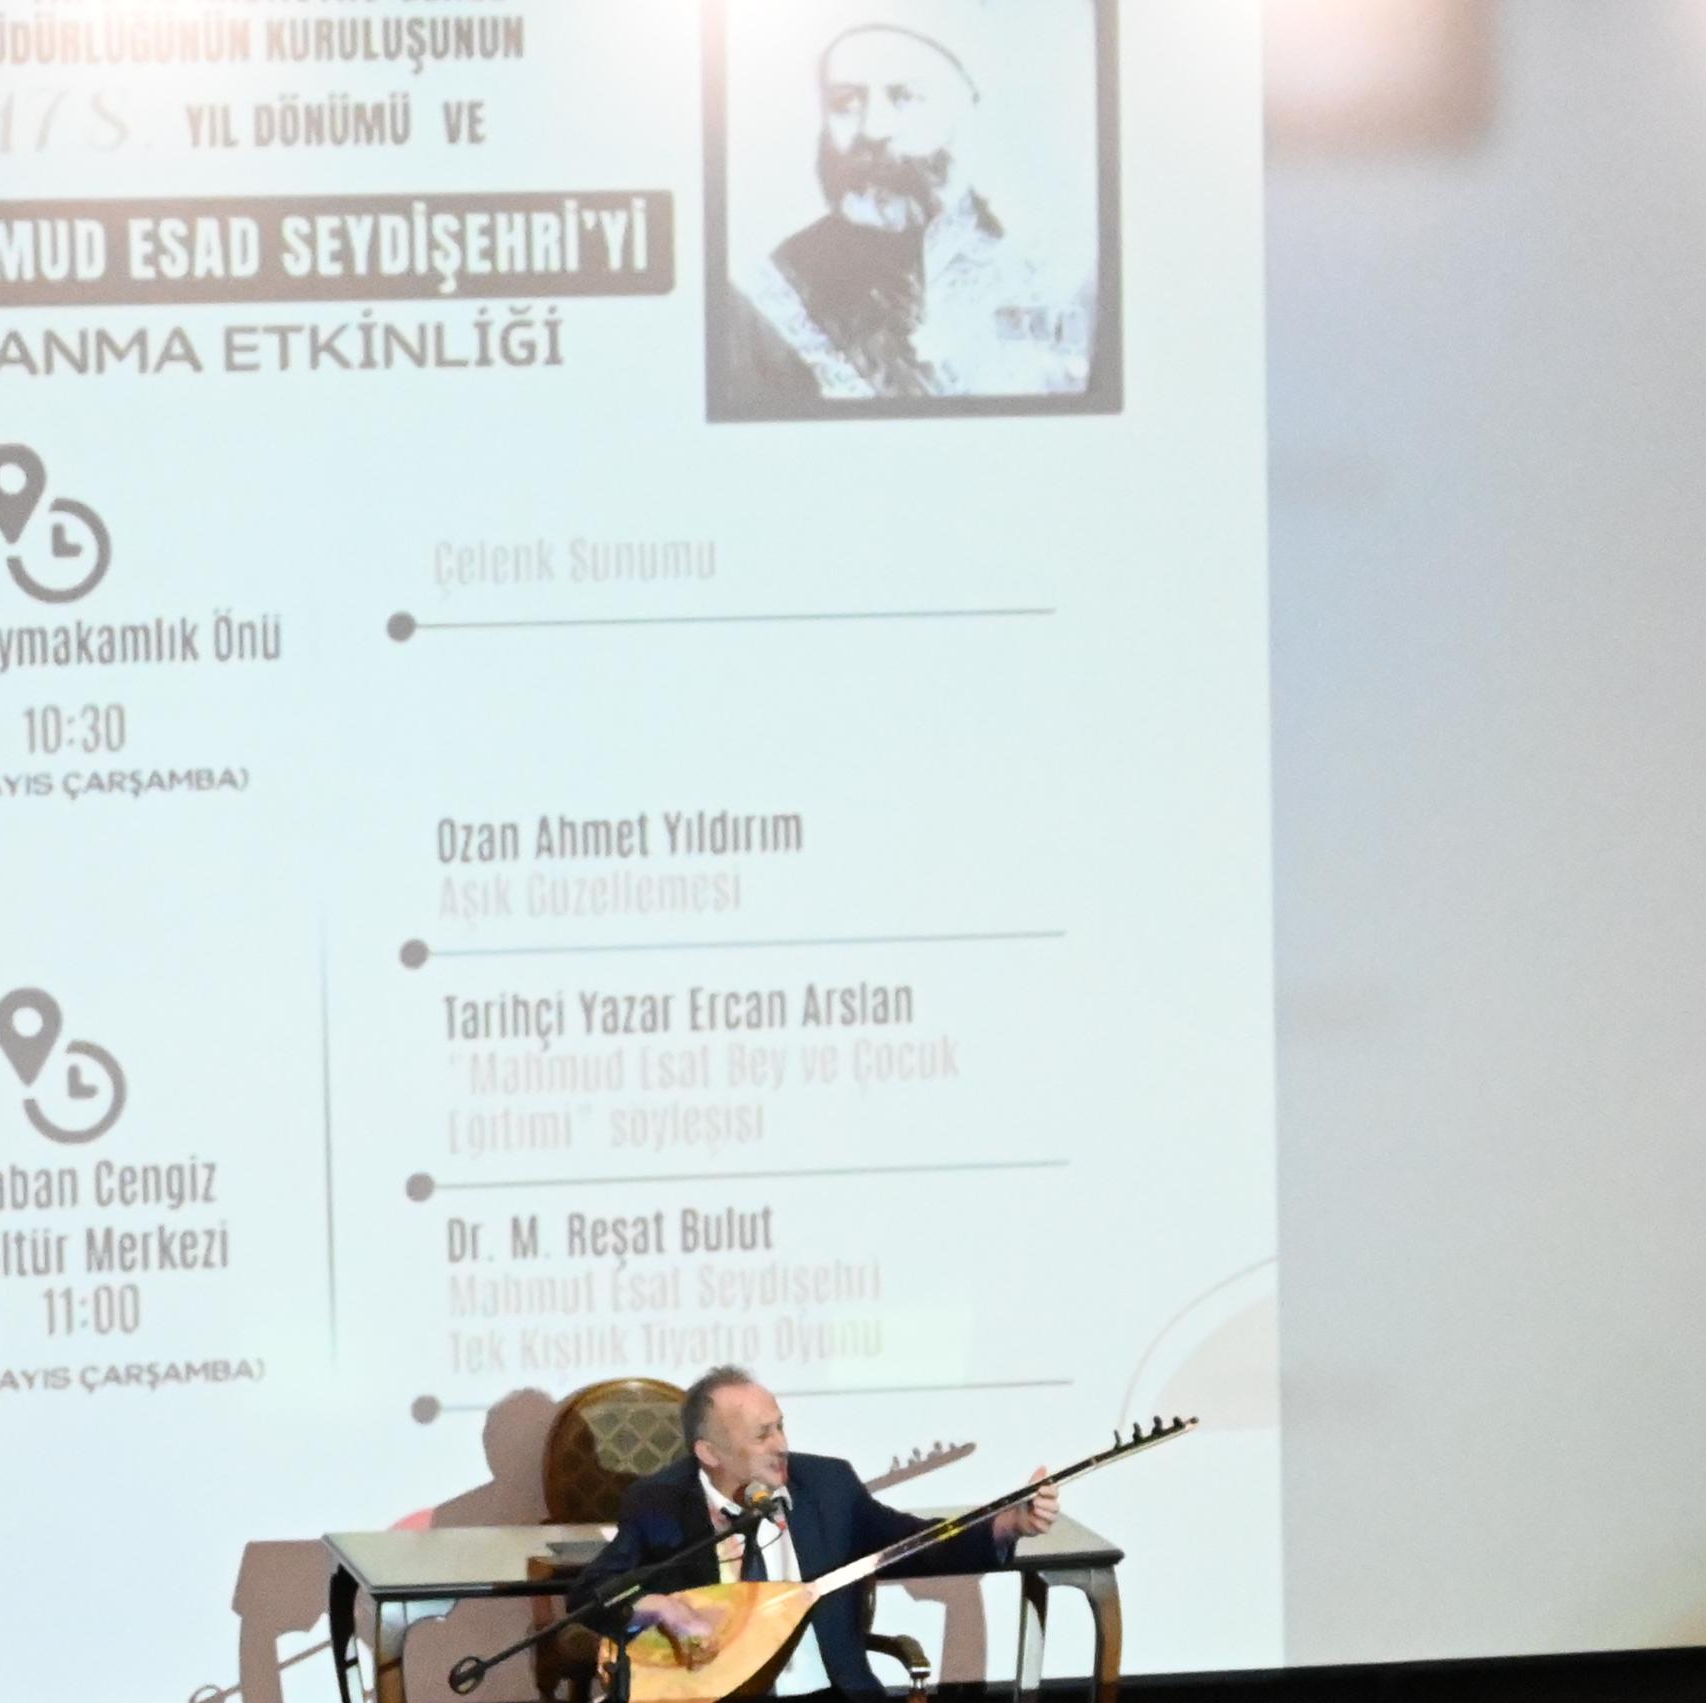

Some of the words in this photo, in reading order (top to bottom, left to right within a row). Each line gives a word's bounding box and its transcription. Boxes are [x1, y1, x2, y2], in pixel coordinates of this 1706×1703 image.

[266, 16, 525, 75] KURULUŞUNUN
[185, 103, 239, 148] YIL
[254, 93, 412, 148] DÖNÜMÜ
[442, 99, 487, 145] VE
[130, 214, 260, 281] ESAD
[281, 198, 650, 295] SEYDİŞEHRİ'Yİ
[223, 304, 564, 372] ETKİNLİĞİ
[433, 539, 556, 597] Çelenk
[568, 535, 717, 584] Sunumu
[213, 607, 282, 663] Önü
[24, 703, 127, 755] 10:30
[63, 766, 250, 801] ÇARŞAMBA)
[436, 817, 519, 864] Ozan
[535, 812, 650, 860] Ahmet
[664, 808, 804, 857] Yıldırım
[444, 992, 566, 1053] Tarihçi
[578, 991, 673, 1034] Yazar
[689, 987, 788, 1030] Ercan
[801, 980, 914, 1028] Arslan
[726, 1040, 788, 1096] Bey
[801, 1046, 838, 1085] ve
[93, 1156, 217, 1211] Cengiz
[85, 1219, 230, 1275] Merkezi
[447, 1217, 495, 1263] Dr.
[511, 1215, 550, 1261] M.
[567, 1207, 666, 1269] Reşat
[681, 1204, 775, 1255] Bulut
[43, 1284, 141, 1337] 11:00
[449, 1327, 508, 1375] Tek
[775, 1313, 883, 1369] Oyunu
[80, 1358, 267, 1394] ÇARŞAMBA)
